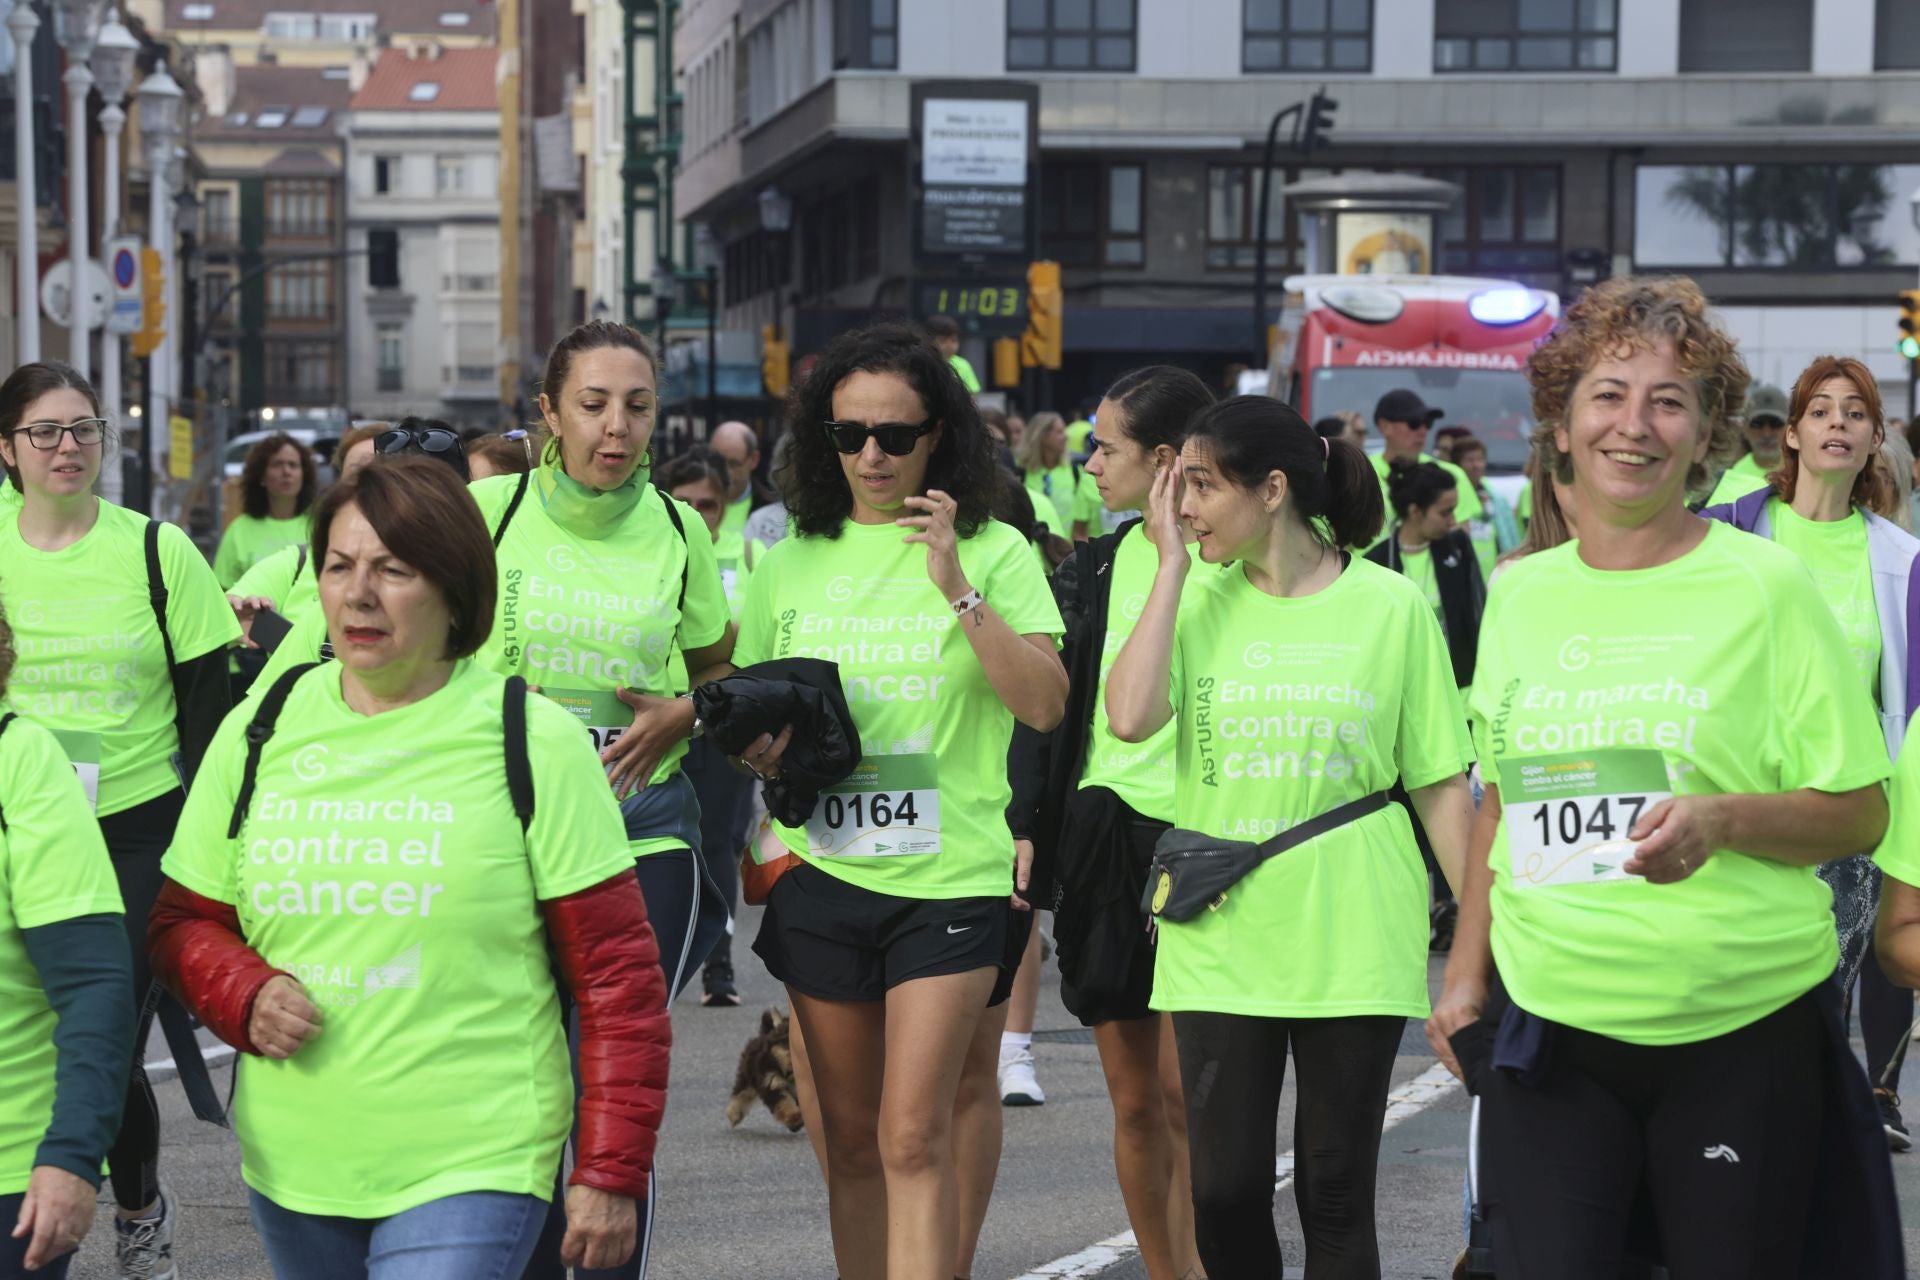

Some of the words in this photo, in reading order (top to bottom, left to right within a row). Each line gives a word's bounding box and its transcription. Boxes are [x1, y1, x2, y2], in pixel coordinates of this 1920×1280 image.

[938, 288, 1018, 316] 11:03
[528, 576, 565, 601] En
[523, 608, 641, 649] contra
[800, 613, 835, 634] En
[840, 611, 951, 634] marcha
[910, 635, 945, 664] el
[113, 656, 139, 681] el
[1220, 681, 1257, 703] En
[1265, 680, 1375, 713] marcha
[1521, 682, 1567, 711] En
[1575, 675, 1711, 711] marcha
[1196, 676, 1219, 788] ASTURIAS
[1218, 708, 1333, 739] contra
[1338, 717, 1368, 748] el
[1514, 712, 1646, 753] contra
[1653, 714, 1697, 753] el
[1221, 740, 1365, 780] cáncer
[259, 792, 297, 822] En
[308, 792, 453, 823] marcha
[825, 792, 919, 829] 0164
[1534, 797, 1645, 846] 1047
[252, 830, 388, 864] contra
[400, 831, 443, 867] el
[254, 867, 444, 917] cáncer
